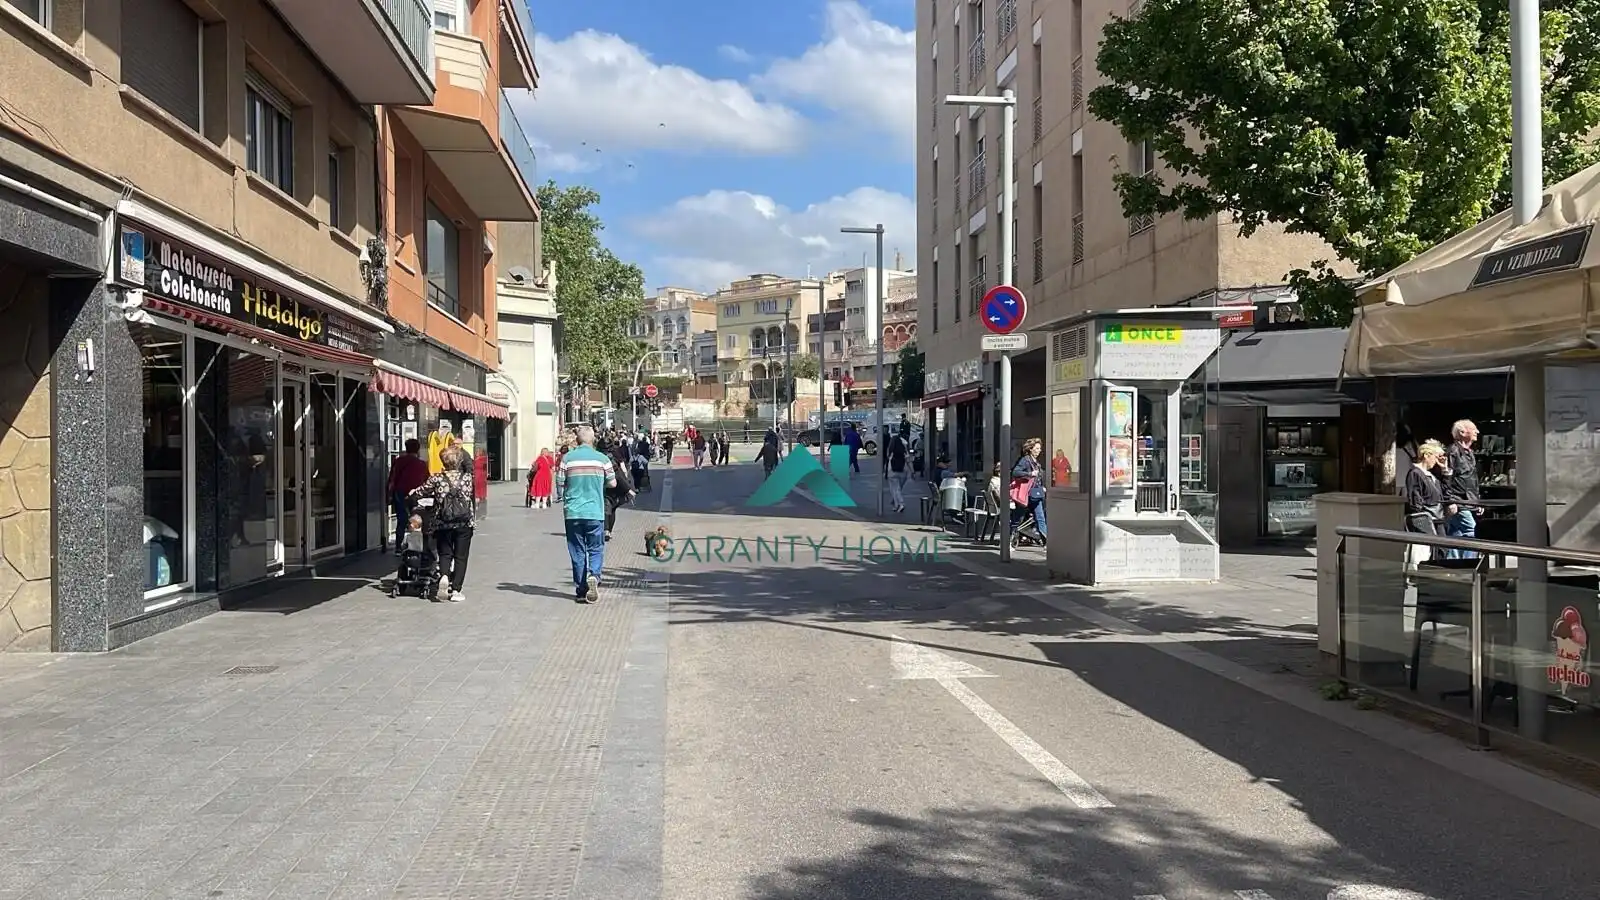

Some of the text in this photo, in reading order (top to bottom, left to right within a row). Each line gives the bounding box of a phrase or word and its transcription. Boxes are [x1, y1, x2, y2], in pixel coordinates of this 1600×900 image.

[160, 241, 233, 292] Matalasseria
[1491, 259, 1505, 275] LA
[160, 268, 231, 314] Colchoneria
[241, 281, 322, 340] Hidalgo
[1128, 327, 1176, 341] ONCE
[1063, 363, 1082, 378] ONCE
[1547, 664, 1591, 687] gelato
